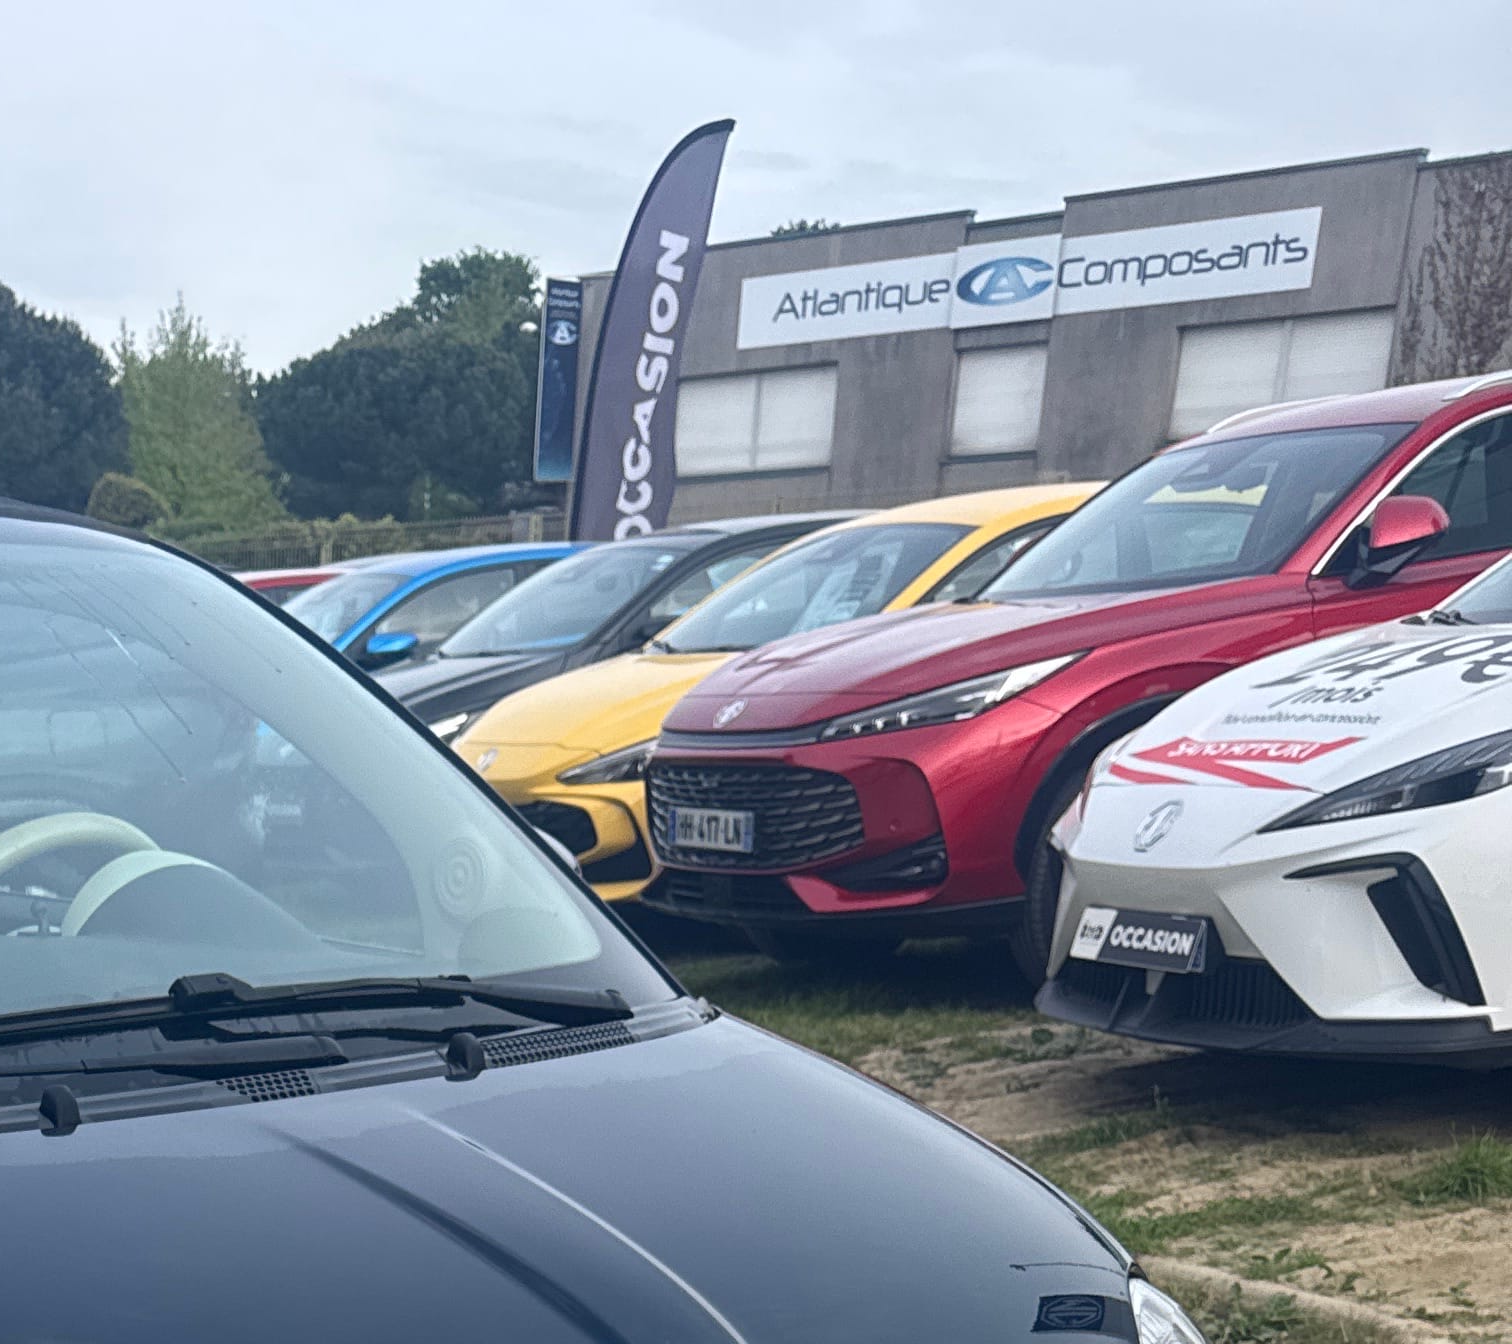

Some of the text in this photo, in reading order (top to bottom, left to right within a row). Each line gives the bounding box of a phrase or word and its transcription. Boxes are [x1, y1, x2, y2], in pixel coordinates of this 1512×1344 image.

[772, 279, 951, 322] Atlantique
[1057, 232, 1309, 287] Composants
[1109, 923, 1196, 956] OCCASION
